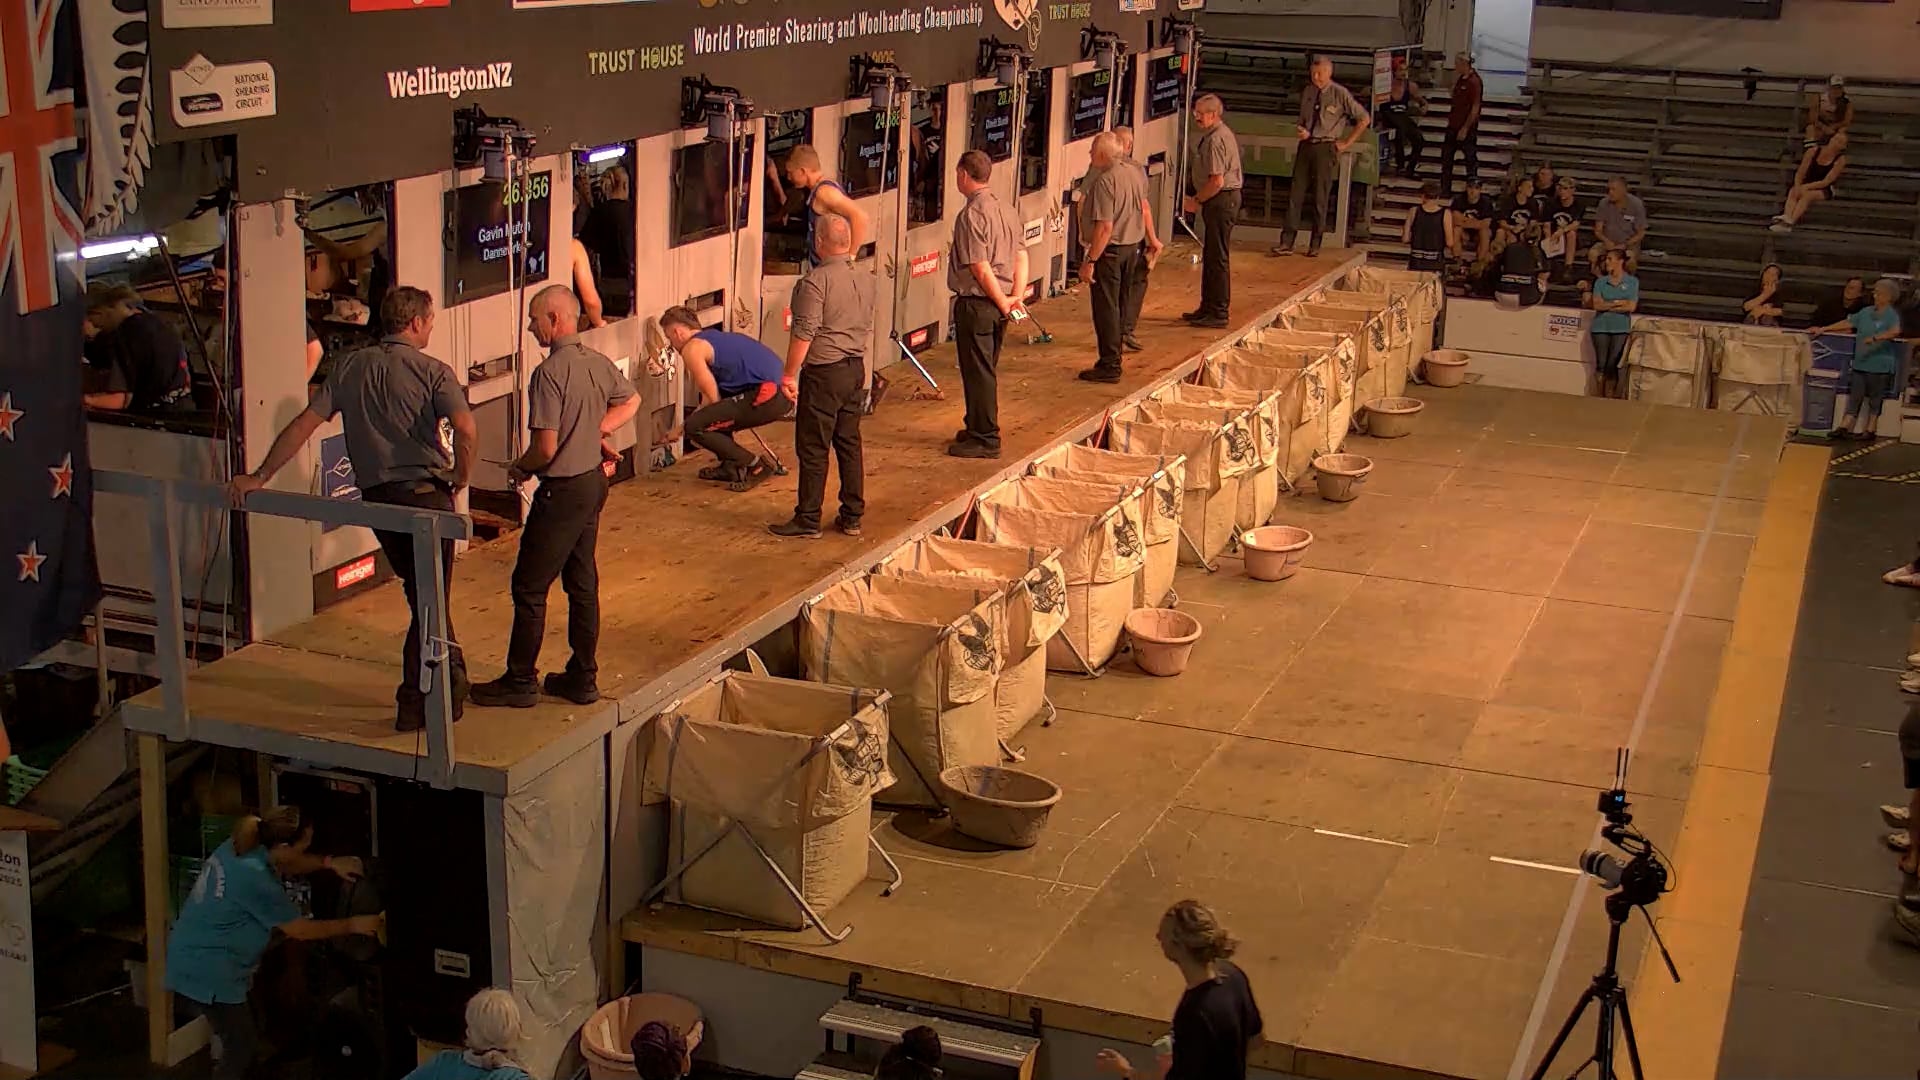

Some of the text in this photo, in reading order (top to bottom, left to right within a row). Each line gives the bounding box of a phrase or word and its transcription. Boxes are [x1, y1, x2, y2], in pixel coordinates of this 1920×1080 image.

[694, 2, 984, 55] World Premier Shearing and Woolhandling Championship
[588, 44, 684, 75] TRUST HOUSE
[234, 72, 270, 84] NATIONAL
[387, 62, 513, 99] WellingtonNZ
[235, 85, 270, 97] SHEARING
[235, 98, 262, 109] CIRCUIT
[478, 225, 503, 243] Gavin
[538, 251, 545, 273] 1
